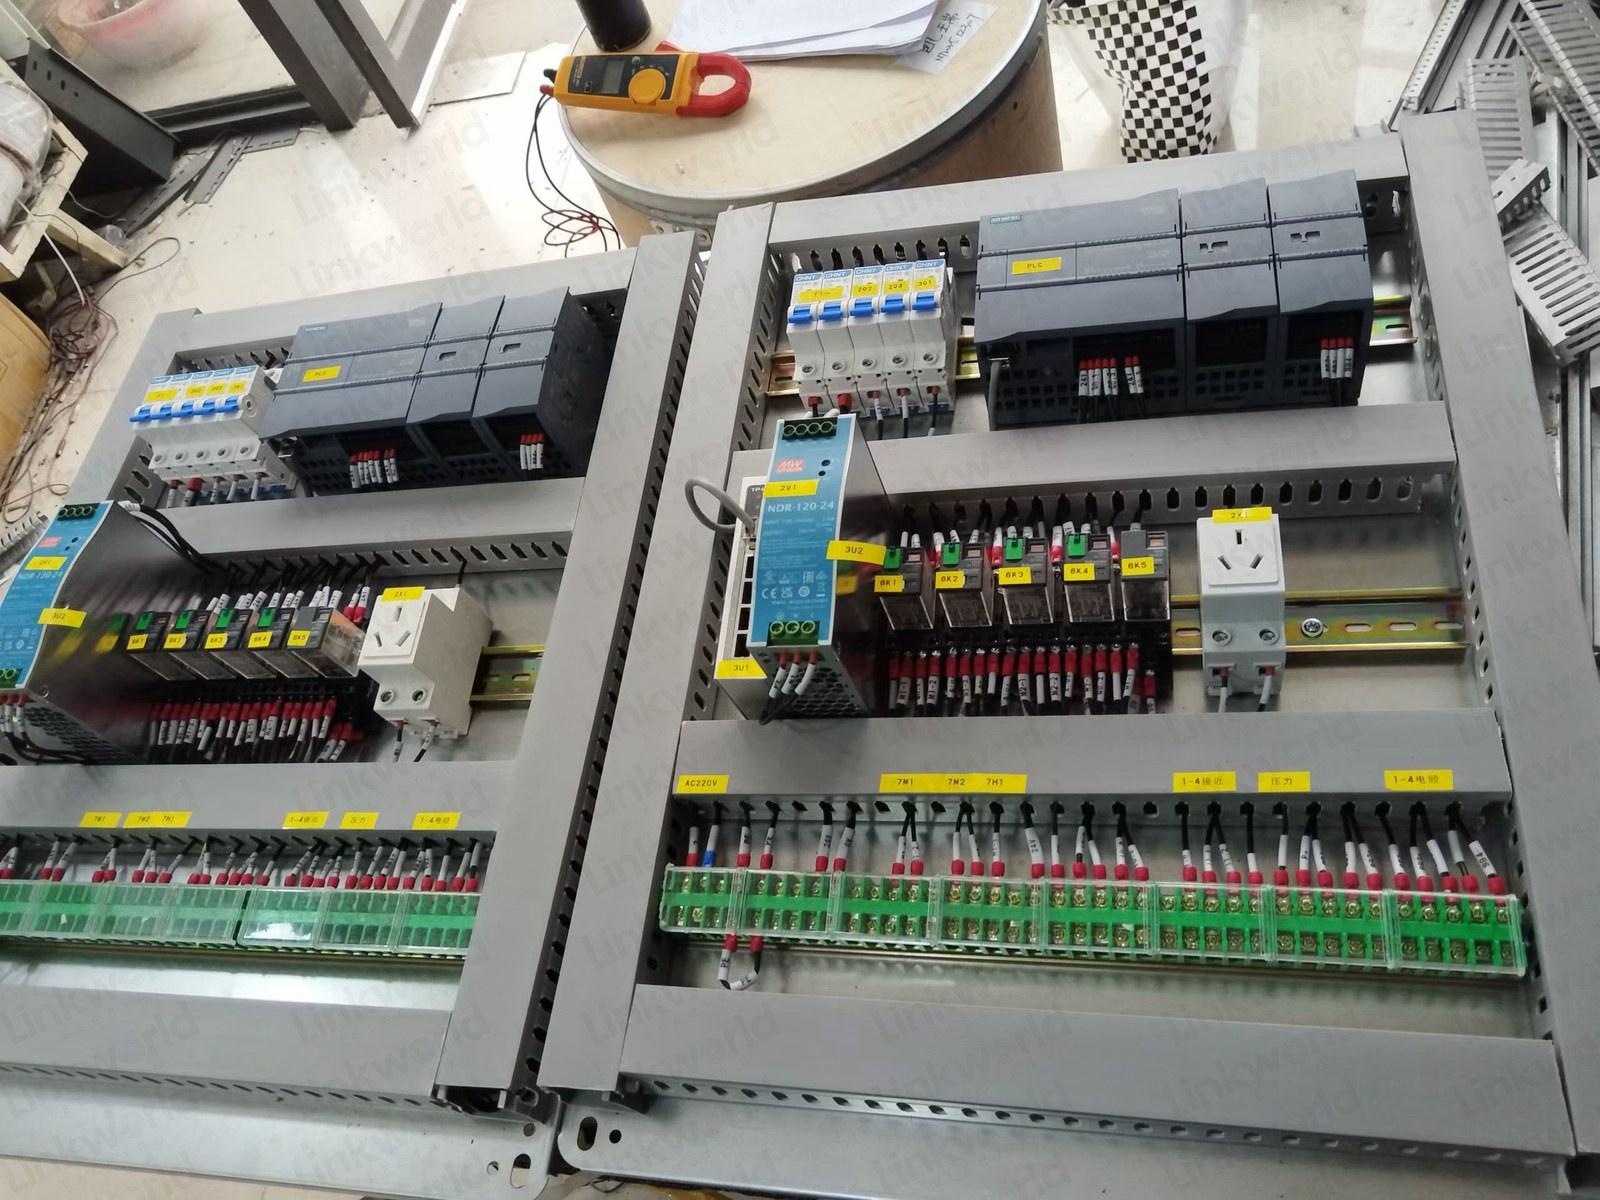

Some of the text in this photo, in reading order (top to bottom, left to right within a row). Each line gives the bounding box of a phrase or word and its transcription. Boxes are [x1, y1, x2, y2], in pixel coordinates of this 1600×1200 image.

[767, 501, 834, 512] NDR-120-24
[845, 546, 863, 554] 3U2
[685, 778, 717, 787] AC220V
[898, 778, 1003, 786] 7M1 7M2 7H1
[1272, 777, 1292, 785] 压力
[720, 957, 729, 967] PE
